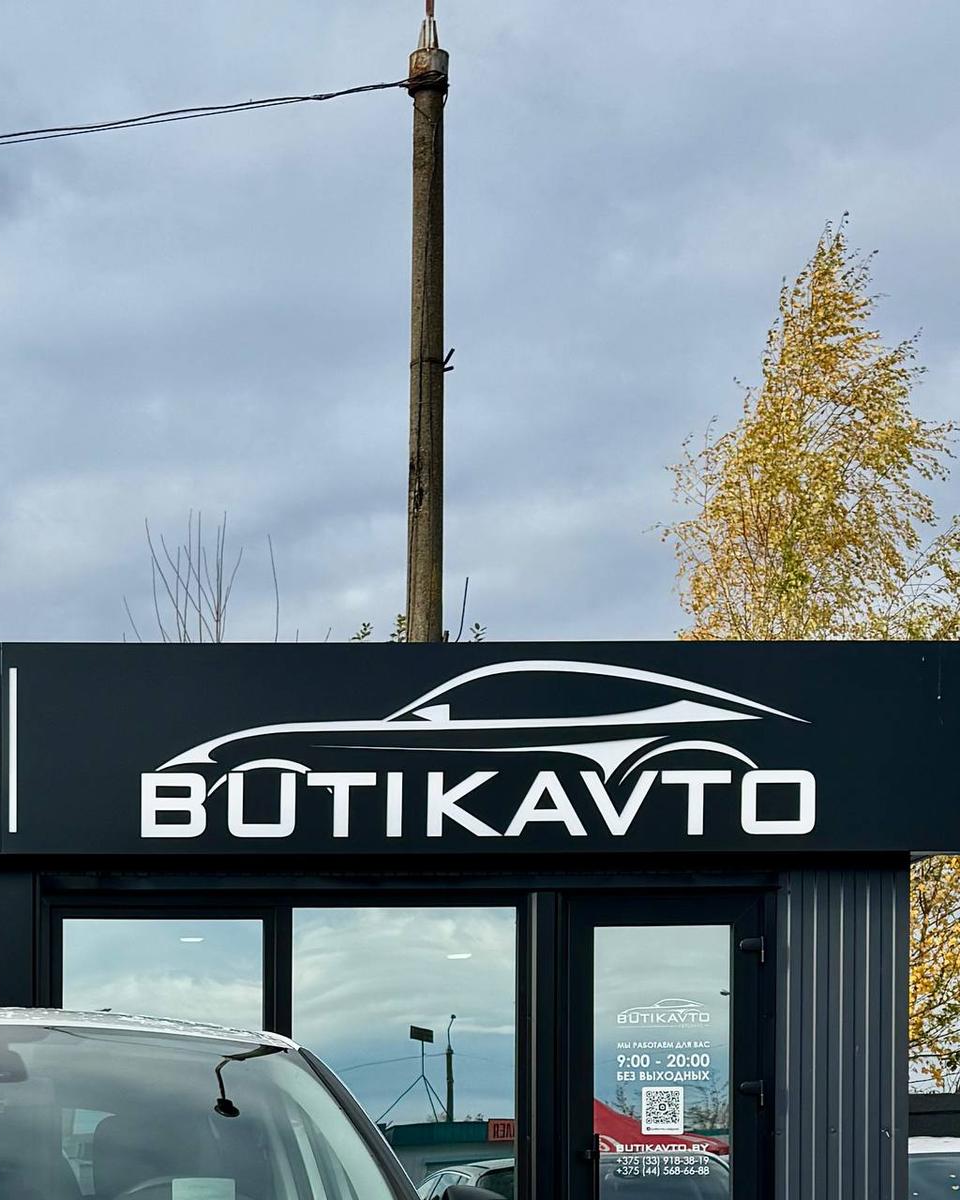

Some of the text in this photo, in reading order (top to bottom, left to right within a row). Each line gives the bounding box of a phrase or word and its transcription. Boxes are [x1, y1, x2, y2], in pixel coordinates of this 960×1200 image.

[141, 768, 817, 839] BUTIKAVTO
[617, 1012, 710, 1023] BUTIKAVTO
[633, 1041, 673, 1049] РАБОТАЕМ
[675, 1041, 691, 1049] ДЛЯ
[617, 1054, 650, 1068] 9:00
[666, 1053, 710, 1068] 20:00
[617, 1071, 710, 1082] БЕЗ ВЫХОДНЫХ
[617, 1144, 709, 1152] BUTIKAVTO.BY
[616, 1156, 710, 1167] +375 (33) 918-38-19
[616, 1166, 710, 1177] +375 (44) 568-66-88
